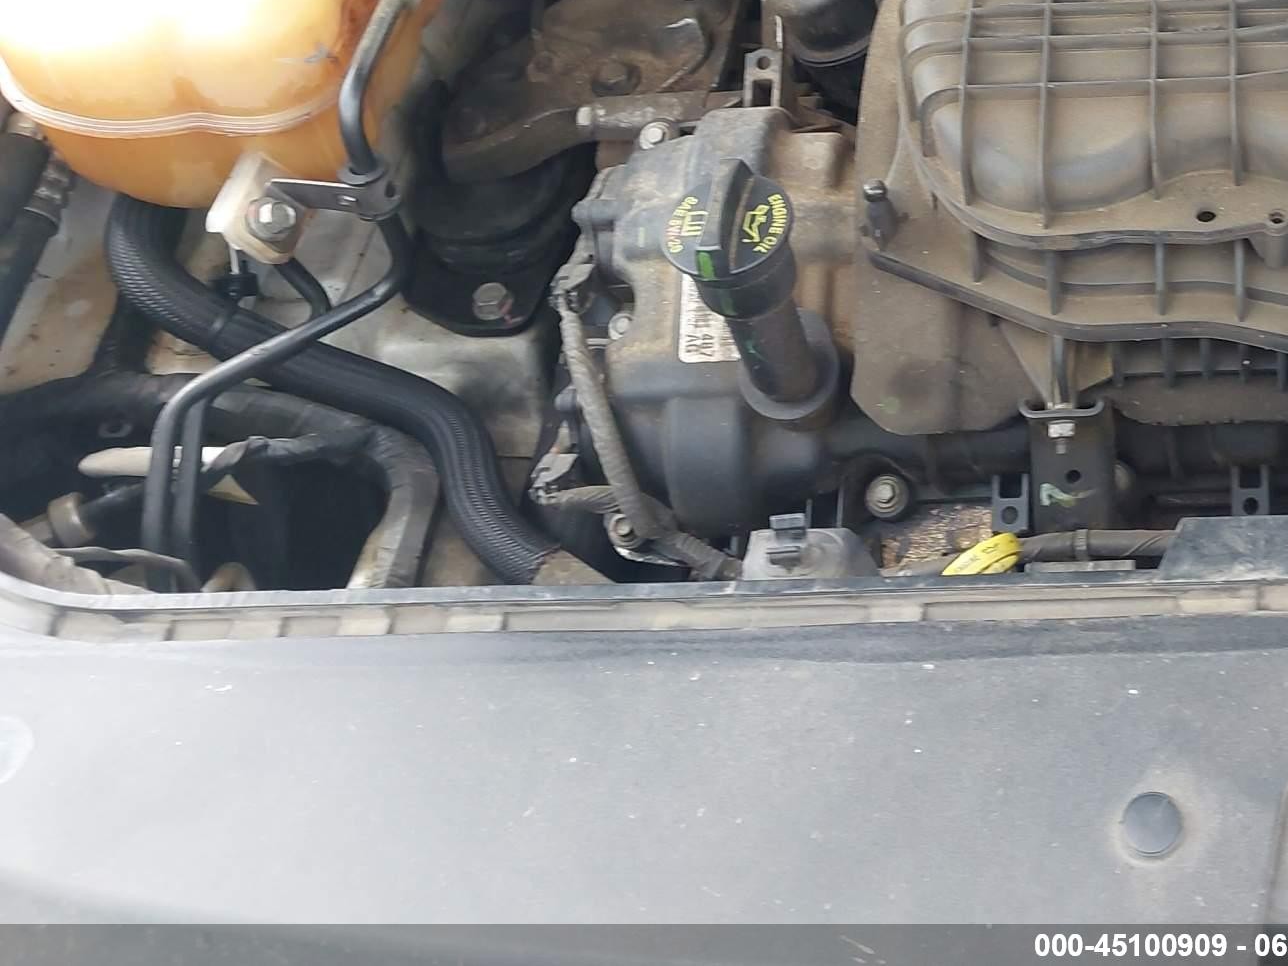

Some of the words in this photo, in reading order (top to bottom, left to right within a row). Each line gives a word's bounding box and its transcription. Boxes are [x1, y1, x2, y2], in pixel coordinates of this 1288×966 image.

[671, 196, 699, 217] SAE
[767, 193, 788, 235] ENGINE
[752, 236, 778, 254] OIL
